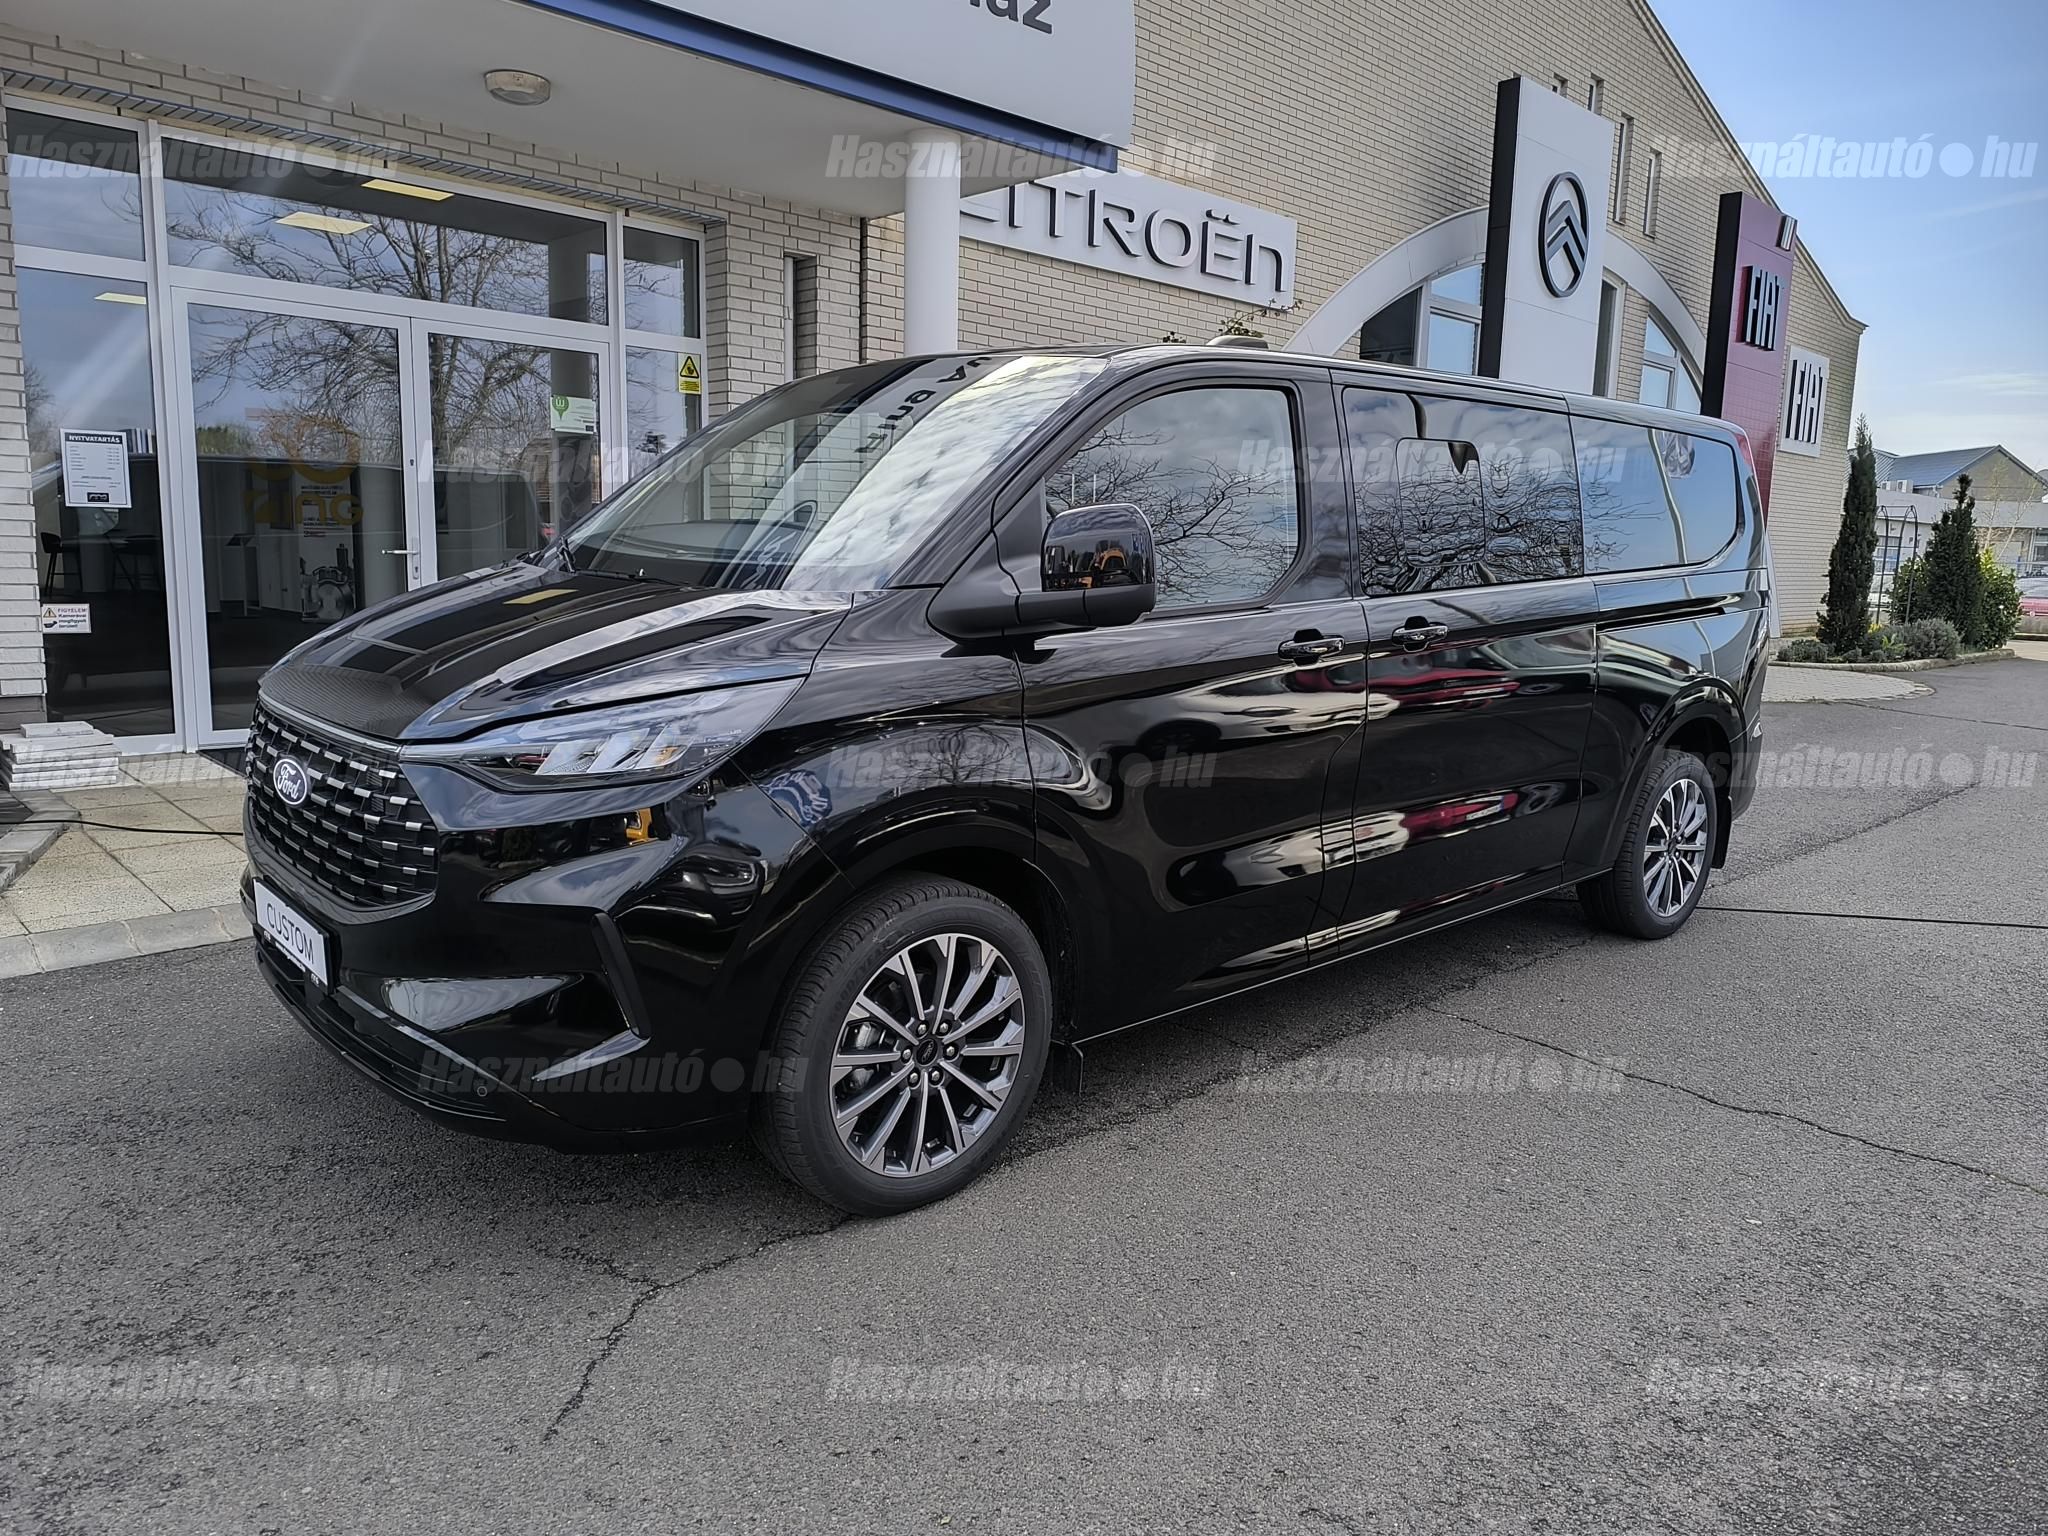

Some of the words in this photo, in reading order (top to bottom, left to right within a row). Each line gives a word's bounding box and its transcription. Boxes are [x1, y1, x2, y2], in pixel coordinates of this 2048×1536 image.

[1746, 266, 1784, 351] FIAT
[1787, 359, 1824, 444] FIAT
[277, 763, 302, 799] Ford
[266, 903, 314, 965] CUSTOM
